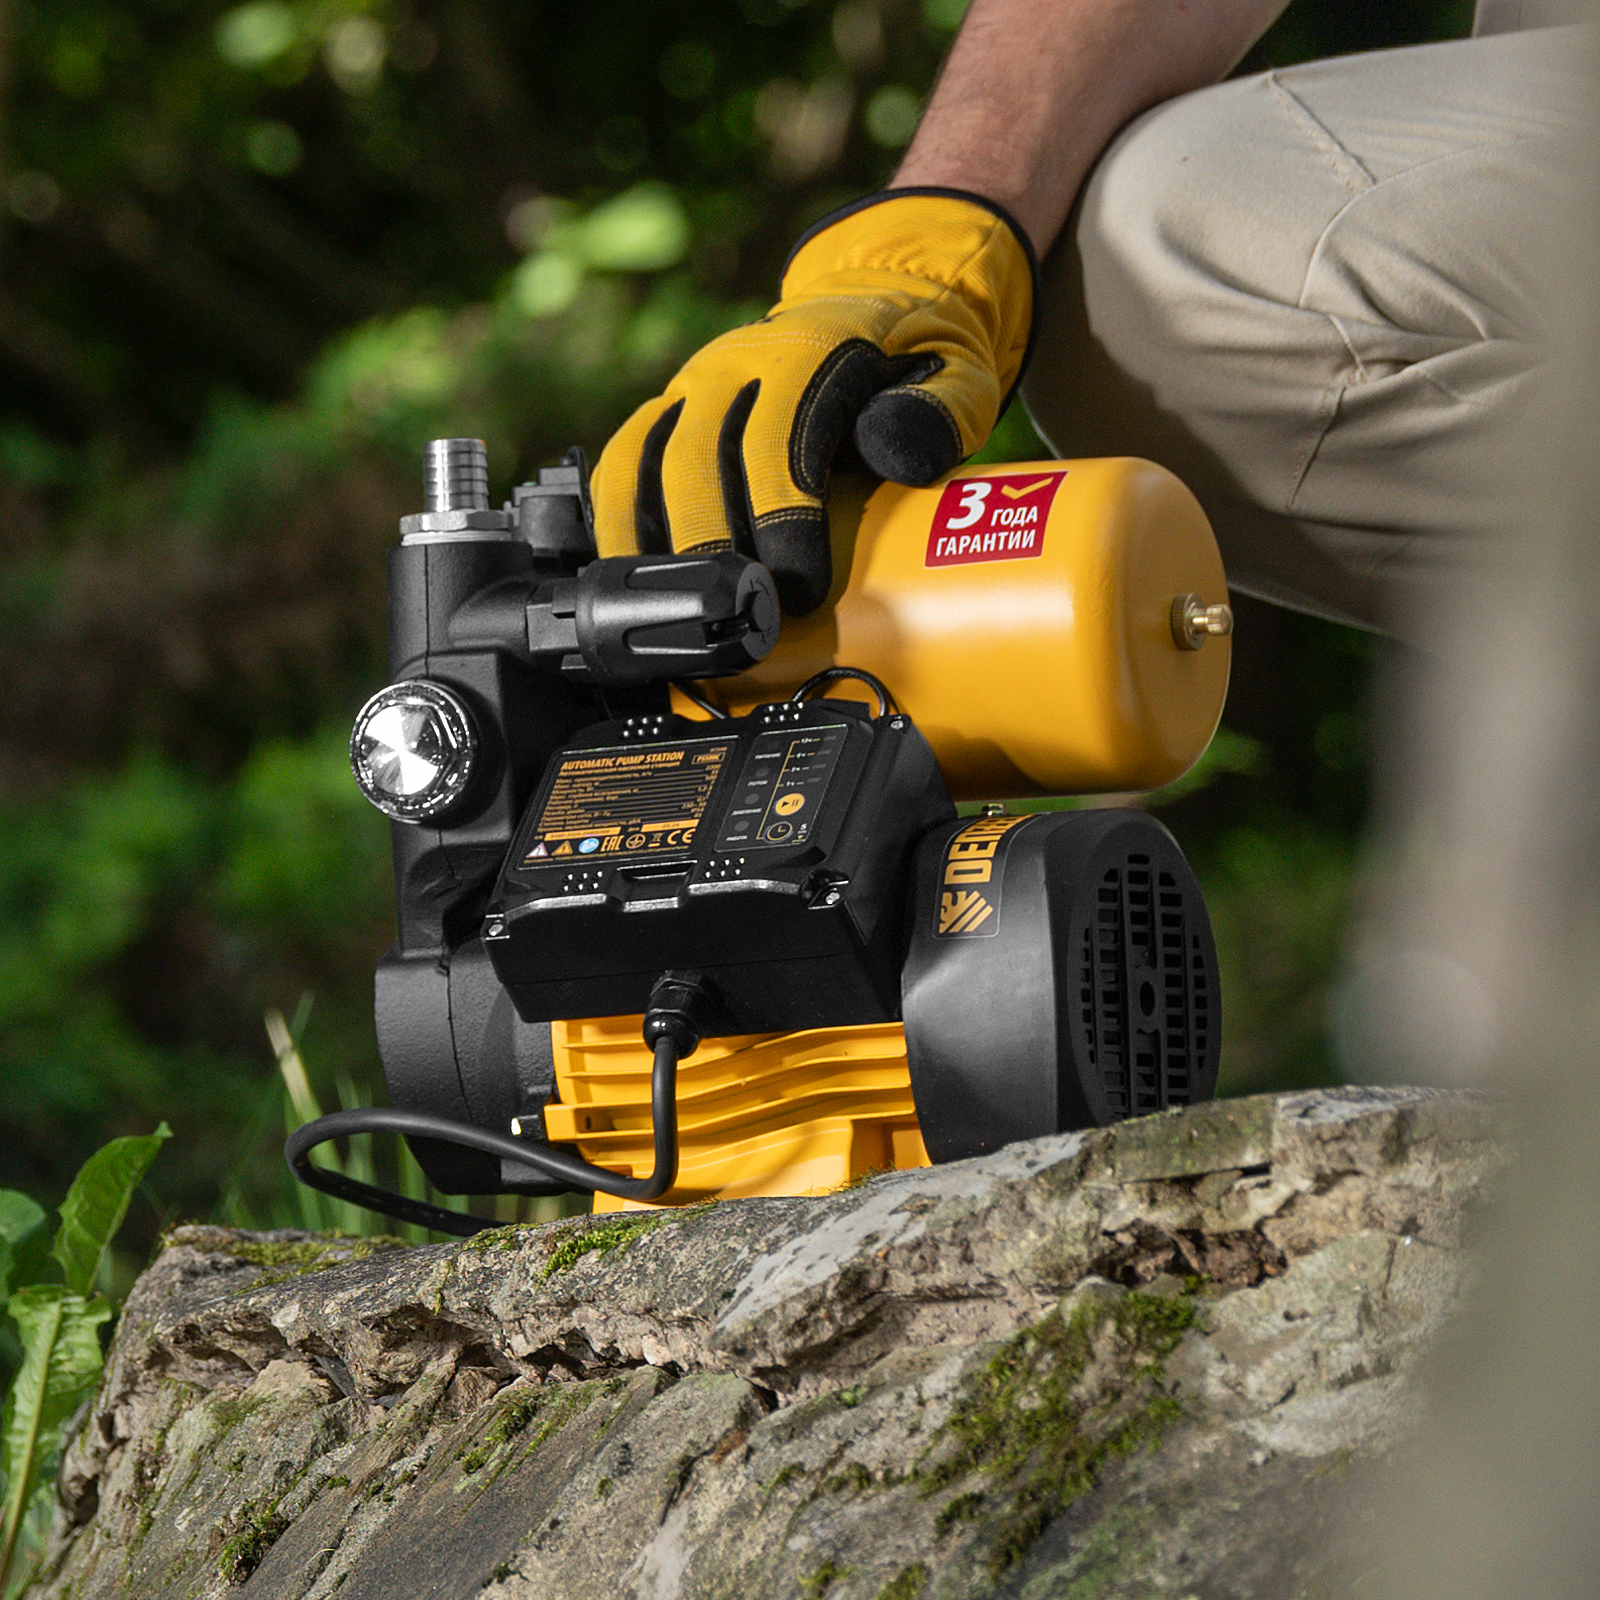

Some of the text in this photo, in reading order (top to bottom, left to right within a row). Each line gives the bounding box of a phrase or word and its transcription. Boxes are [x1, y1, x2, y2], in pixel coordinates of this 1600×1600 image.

[945, 481, 1038, 530] 3 ГОДА
[935, 529, 1036, 557] ГАРАНТИИ
[560, 750, 685, 771] AUTOMATIC PUMP STATION
[667, 828, 696, 845] CE
